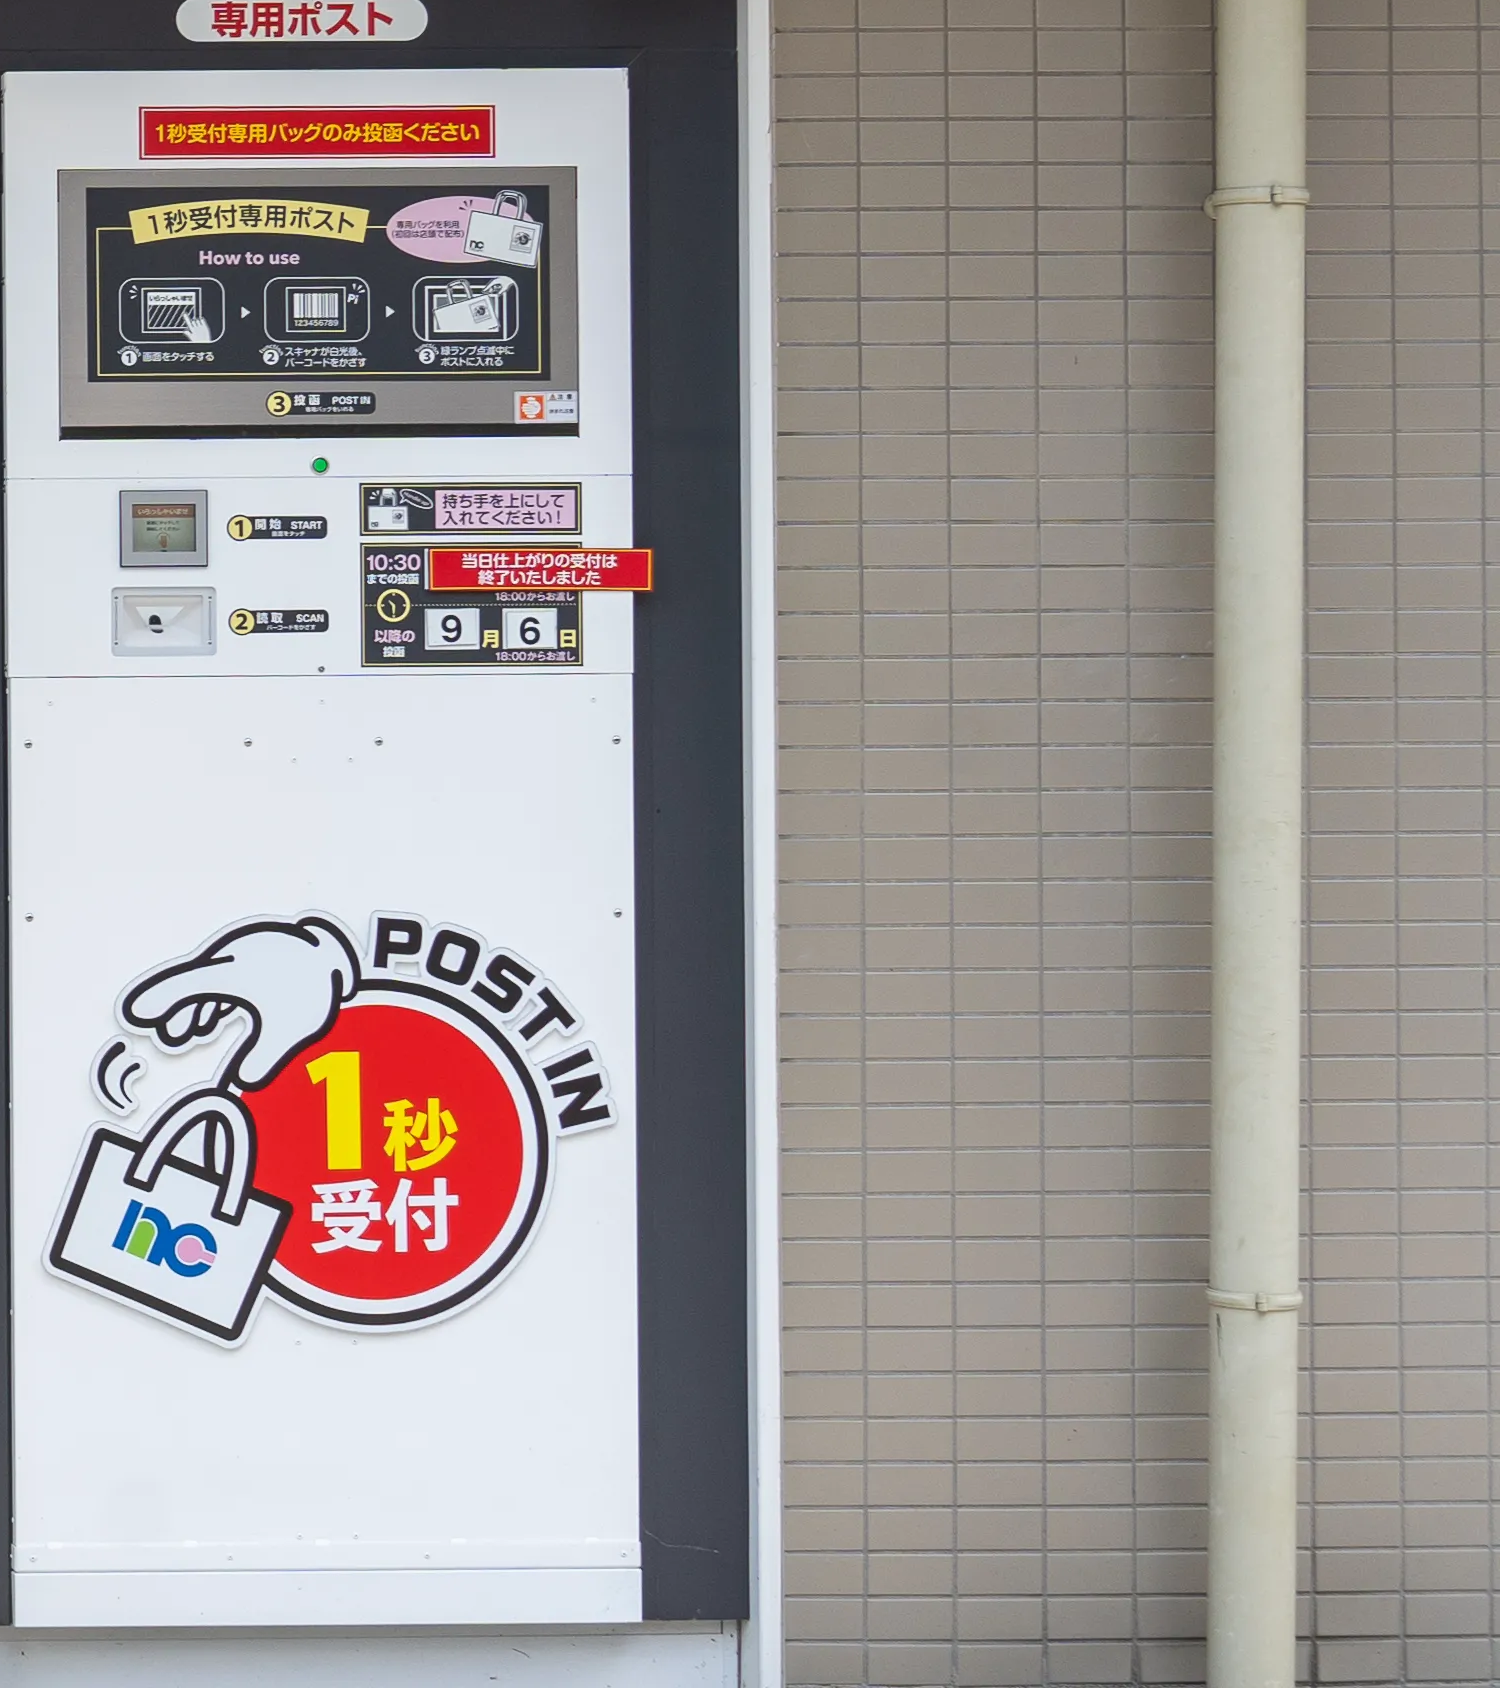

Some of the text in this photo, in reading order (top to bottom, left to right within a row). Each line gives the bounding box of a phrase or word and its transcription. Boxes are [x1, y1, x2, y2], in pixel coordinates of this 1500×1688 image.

[210, 1, 394, 38] 専用ポスト
[154, 120, 480, 146] 1秒受付専用バッグのみ投函ください
[146, 203, 356, 236] 1秒受付専用ポスト
[396, 220, 461, 230] 専用バッグを利用
[198, 250, 300, 266] How to use
[142, 350, 215, 363] 画面をタッチする
[284, 357, 368, 368] バーコードをかざす
[440, 357, 505, 367] ポストに入れる
[332, 395, 358, 405] POST
[442, 493, 565, 509] 持ち手を上にして
[291, 520, 323, 530] START
[367, 554, 421, 570] 10:30
[462, 553, 618, 569] 当日仕上がりの受付は
[477, 570, 601, 585] 終了いたしました
[296, 614, 325, 623] SCAN
[374, 629, 416, 643] 以降の
[371, 914, 611, 1133] POST IN
[305, 1048, 459, 1173] 1秒
[309, 1177, 460, 1254] 受付
